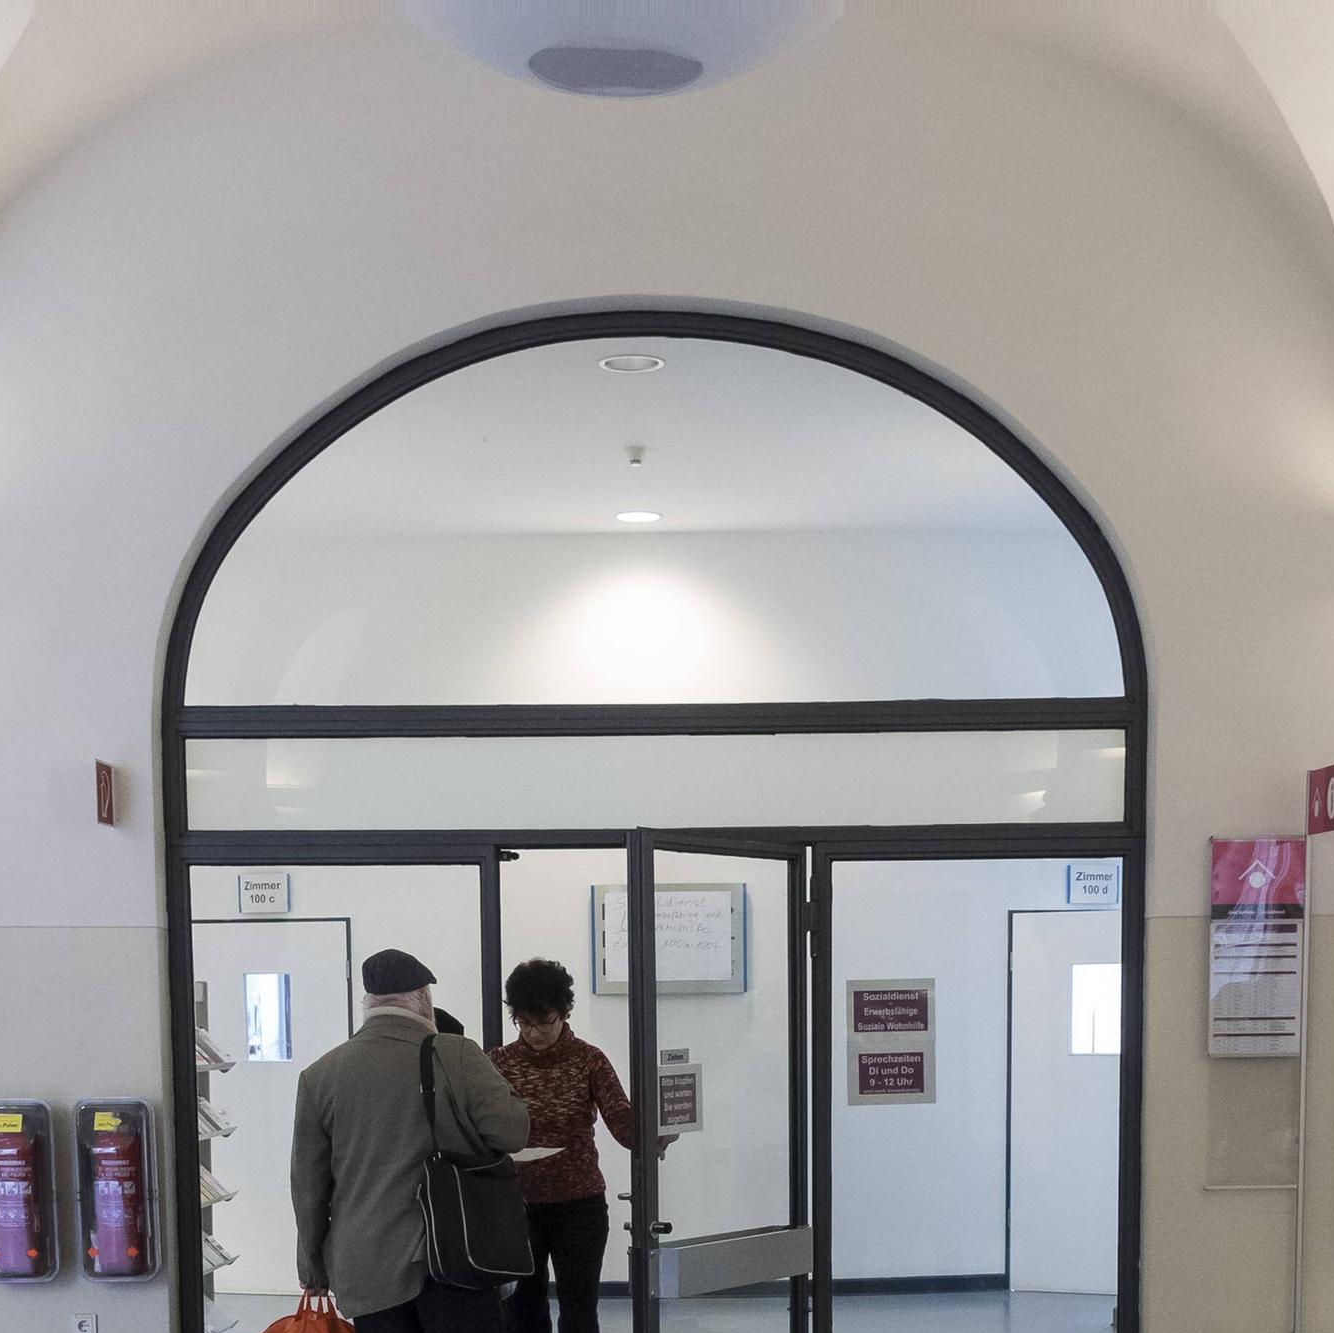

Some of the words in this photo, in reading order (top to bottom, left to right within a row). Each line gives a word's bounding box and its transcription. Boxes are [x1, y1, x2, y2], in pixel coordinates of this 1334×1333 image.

[1076, 871, 1113, 881] Zimmer
[244, 881, 281, 891] Zimmer
[1083, 885, 1100, 894] 100
[1102, 885, 1108, 894] d
[250, 894, 266, 903] 100
[269, 895, 275, 903] c
[862, 992, 919, 1001] Sozialdienst
[864, 1007, 918, 1016] Erwerbsfähige
[857, 1021, 885, 1031] Soziale
[886, 1020, 925, 1030] Wohnhilfe
[861, 1055, 921, 1066] Sprechzeiten
[869, 1066, 879, 1075] Di
[881, 1066, 898, 1075] und
[900, 1065, 914, 1074] Do
[884, 1078, 894, 1086] 12
[896, 1077, 914, 1086] Uhr
